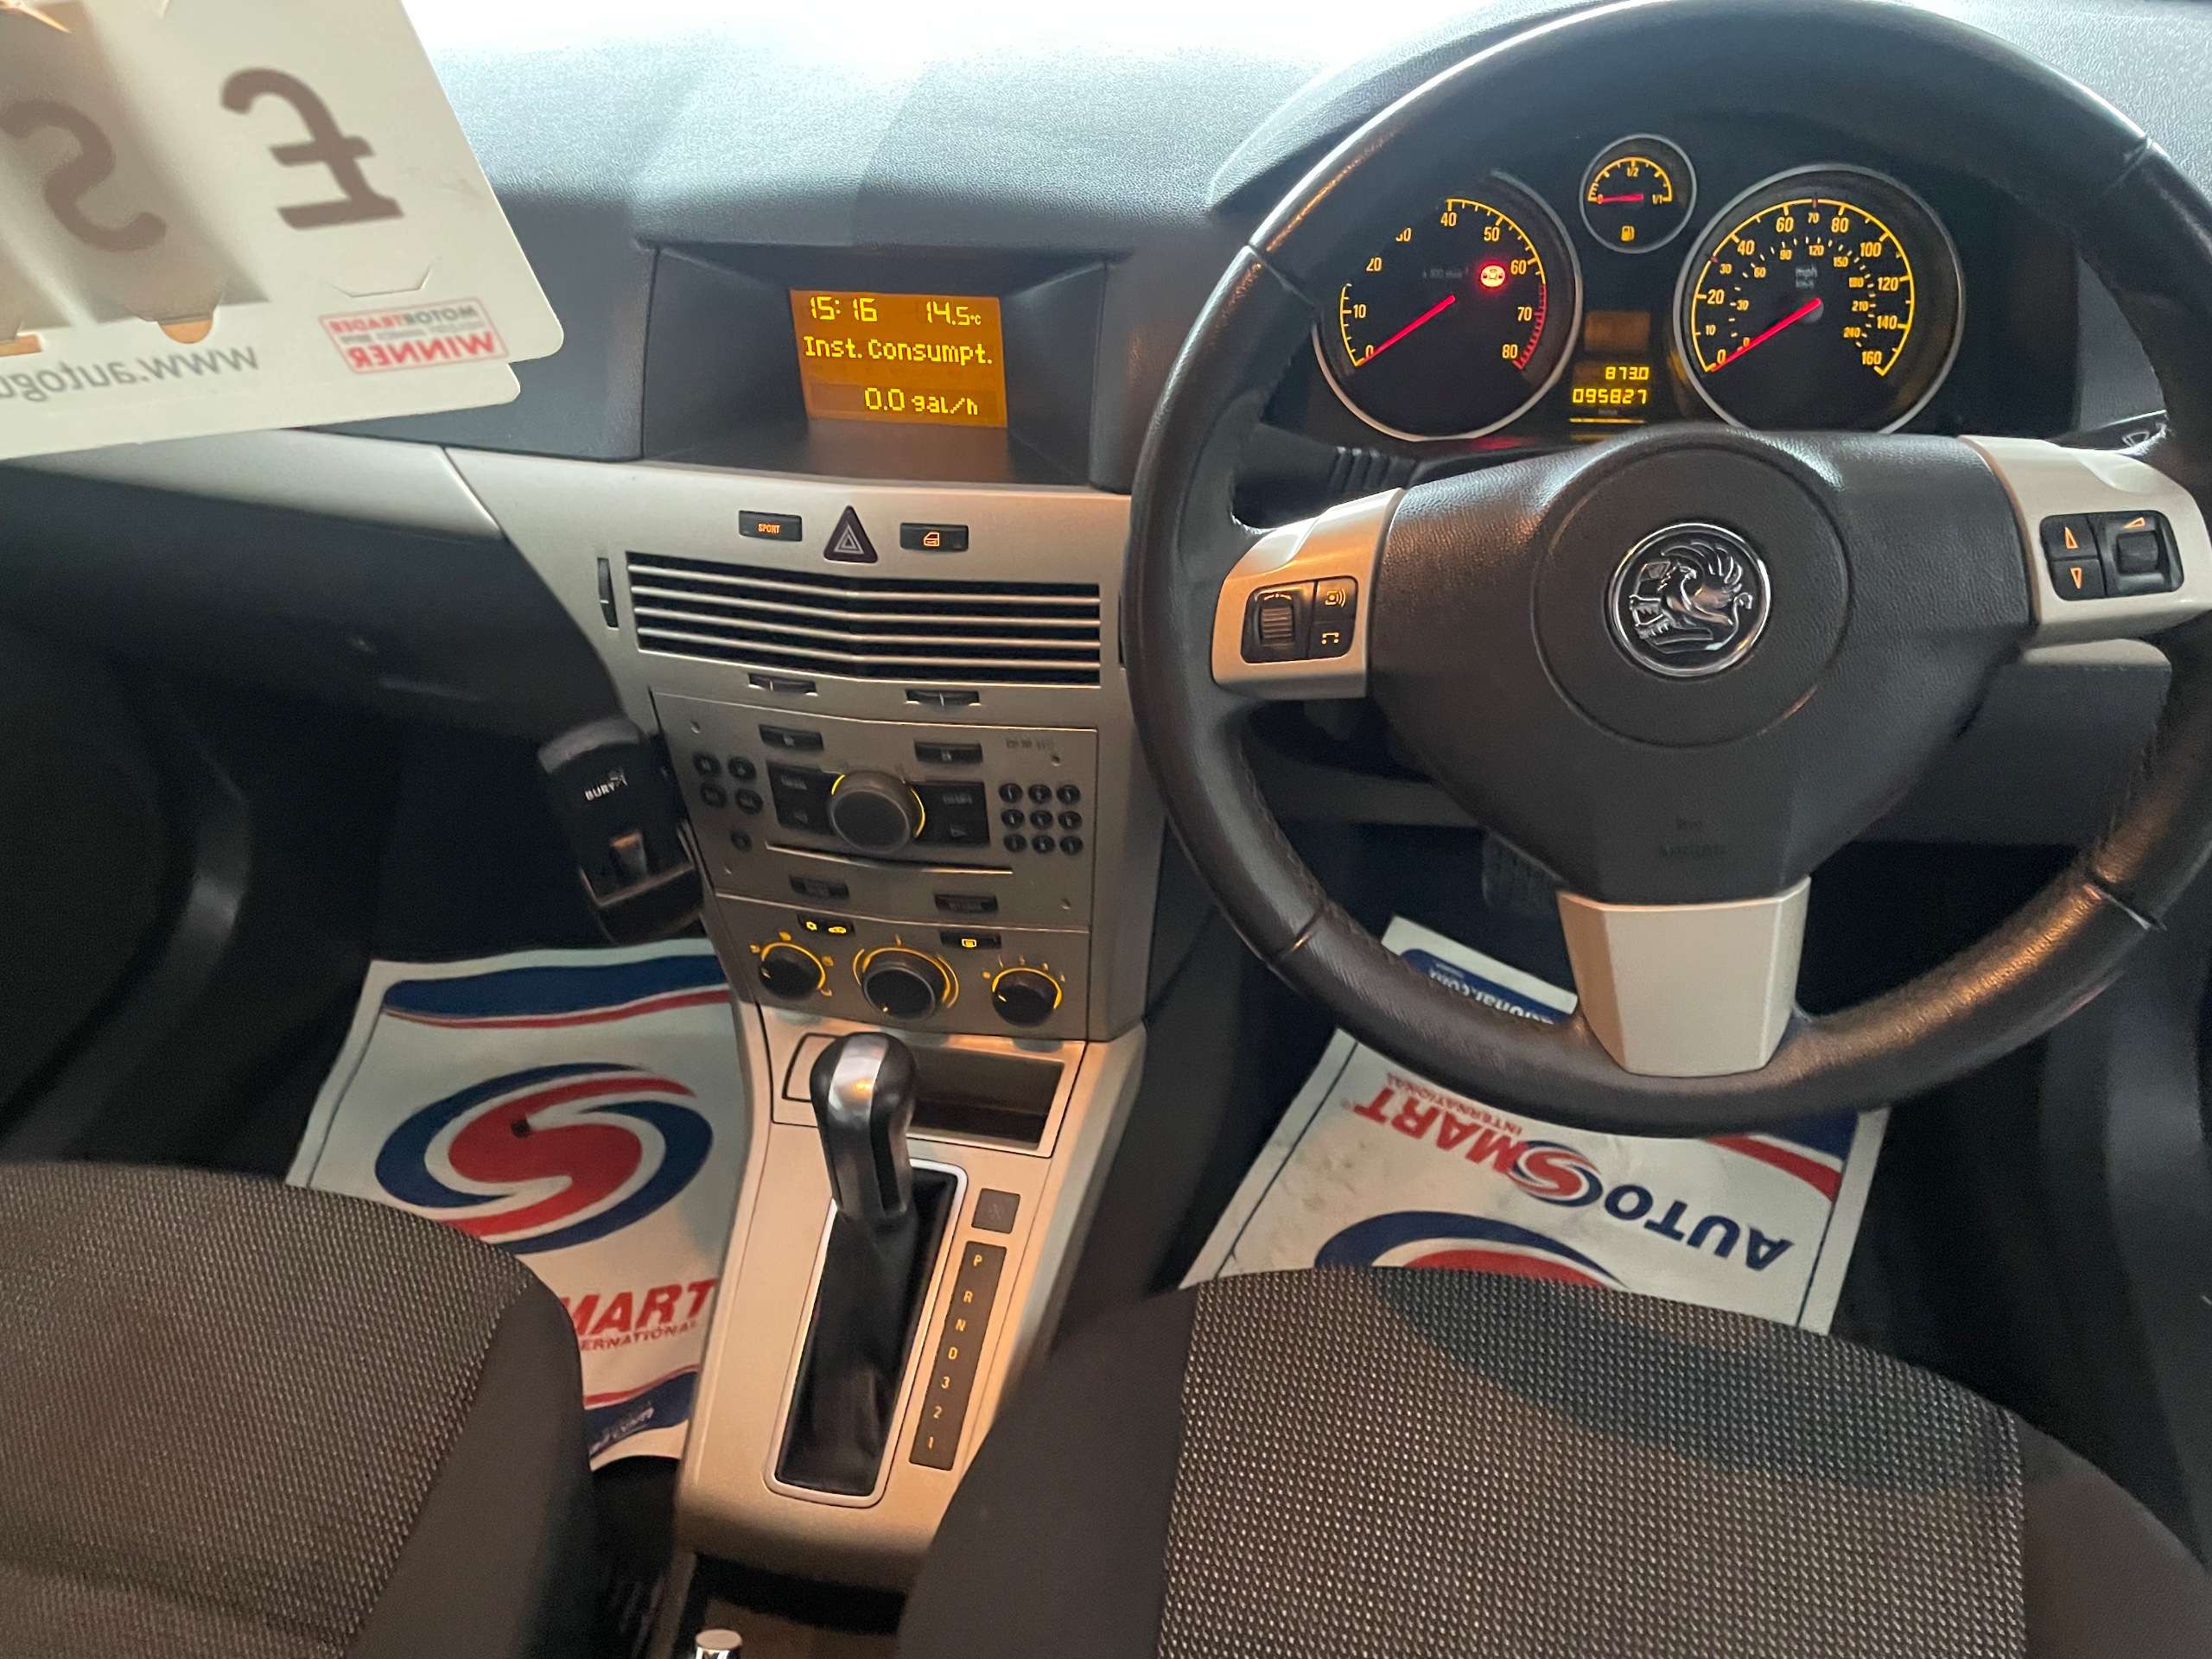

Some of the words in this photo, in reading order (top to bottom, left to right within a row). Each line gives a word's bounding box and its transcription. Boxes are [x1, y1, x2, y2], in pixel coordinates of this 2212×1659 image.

[1440, 213, 1457, 227] 40
[1776, 217, 1795, 232] 60
[1808, 213, 1820, 224] 70
[1831, 218, 1849, 233] 80
[1484, 227, 1500, 242] 50
[1738, 240, 1755, 256] 40
[1808, 245, 1825, 256] 120
[1860, 242, 1882, 257] 100
[1366, 257, 1382, 272] 20
[1510, 260, 1527, 275] 60
[1719, 264, 1732, 274] 30
[1834, 257, 1849, 267] 150
[1754, 267, 1766, 278] 60
[1878, 277, 1899, 291] 120
[1707, 289, 1725, 305] 20
[1353, 304, 1367, 319] 10
[1737, 300, 1750, 310] 30
[1852, 301, 1869, 312] 210
[1517, 307, 1533, 321] 70
[1877, 315, 1898, 329] 140
[1706, 324, 1716, 335] 10
[1843, 327, 1861, 338] 240
[868, 339, 992, 366] Consumpt.
[1502, 345, 1518, 359] 80
[1717, 349, 1726, 364] 0
[1862, 351, 1883, 365] 160
[864, 388, 906, 411] 0.0
[911, 395, 978, 416] gal/h
[1573, 388, 1647, 404] 095827
[758, 523, 780, 534] SPORT
[584, 782, 615, 801] BURY
[973, 1255, 982, 1267] P
[963, 1290, 974, 1303] R
[955, 1319, 966, 1332] N
[948, 1347, 958, 1360] D
[941, 1376, 950, 1389] 3
[933, 1406, 943, 1419] 2
[927, 1436, 934, 1449] 1
